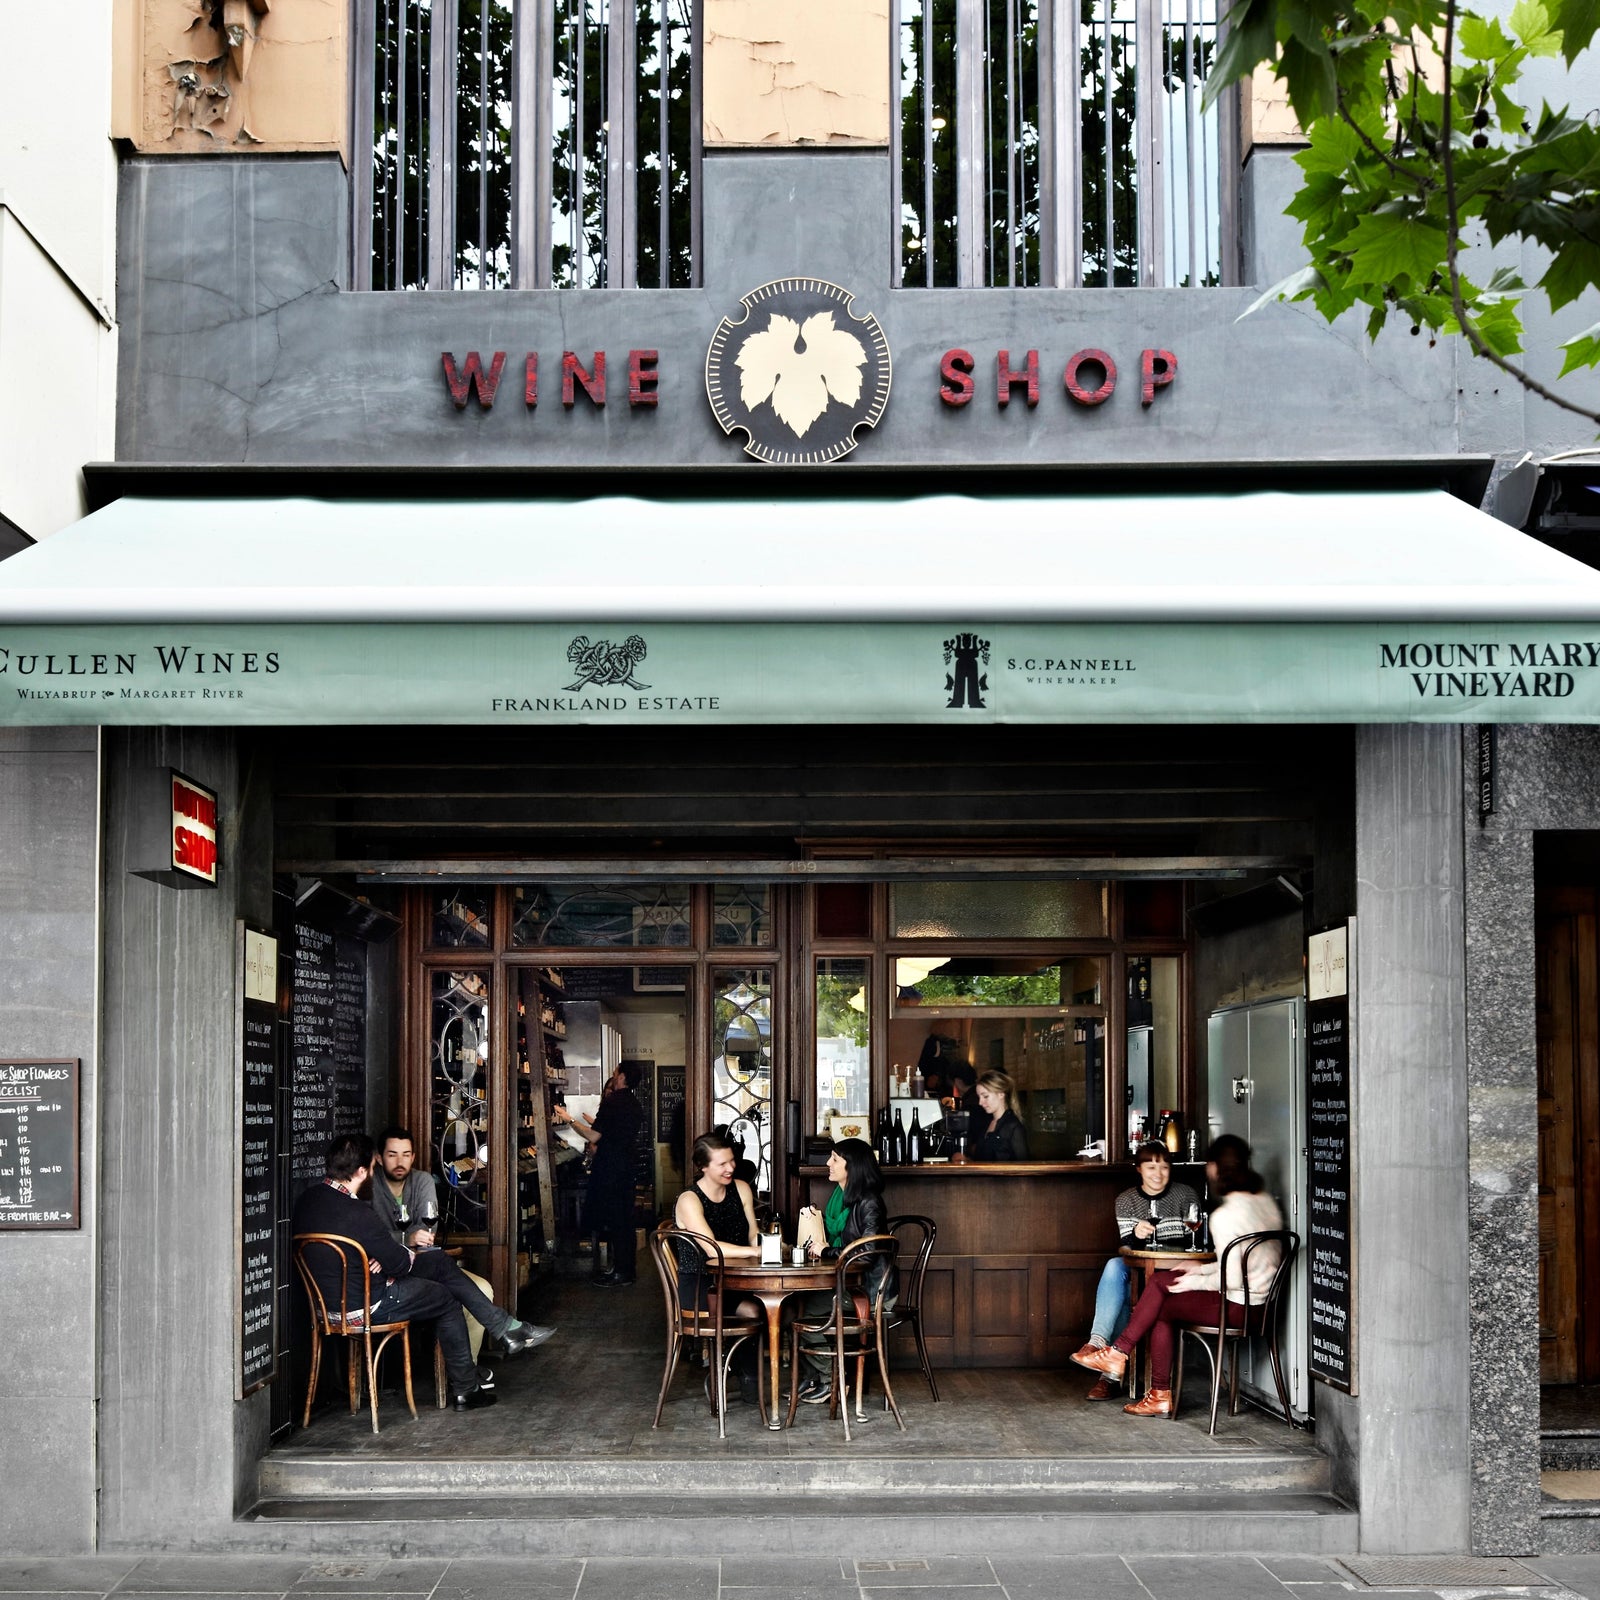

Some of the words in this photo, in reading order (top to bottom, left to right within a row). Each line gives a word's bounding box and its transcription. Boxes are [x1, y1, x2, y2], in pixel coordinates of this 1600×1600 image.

[441, 350, 659, 408] WINE
[938, 347, 1178, 407] SHOP
[153, 646, 280, 674] WINES
[1379, 643, 1500, 668] MOUNT
[1508, 642, 1600, 667] MARY
[1026, 676, 1117, 685] WINEMAKER
[1410, 672, 1575, 697] VINEYARD
[17, 688, 97, 699] WILYABRUP
[120, 688, 196, 699] MARGARET
[202, 688, 244, 699] RIVER
[492, 698, 627, 711] FRANKLAND
[638, 697, 720, 710] ESTATE
[1481, 732, 1491, 776] SUPPER
[1482, 781, 1491, 811] CLUB
[788, 861, 817, 872] 159
[9, 1066, 29, 1081] SHOP
[30, 1066, 69, 1081] FLOWERS
[7, 1212, 28, 1221] FROM
[28, 1212, 43, 1221] THE
[43, 1211, 60, 1221] BAR
